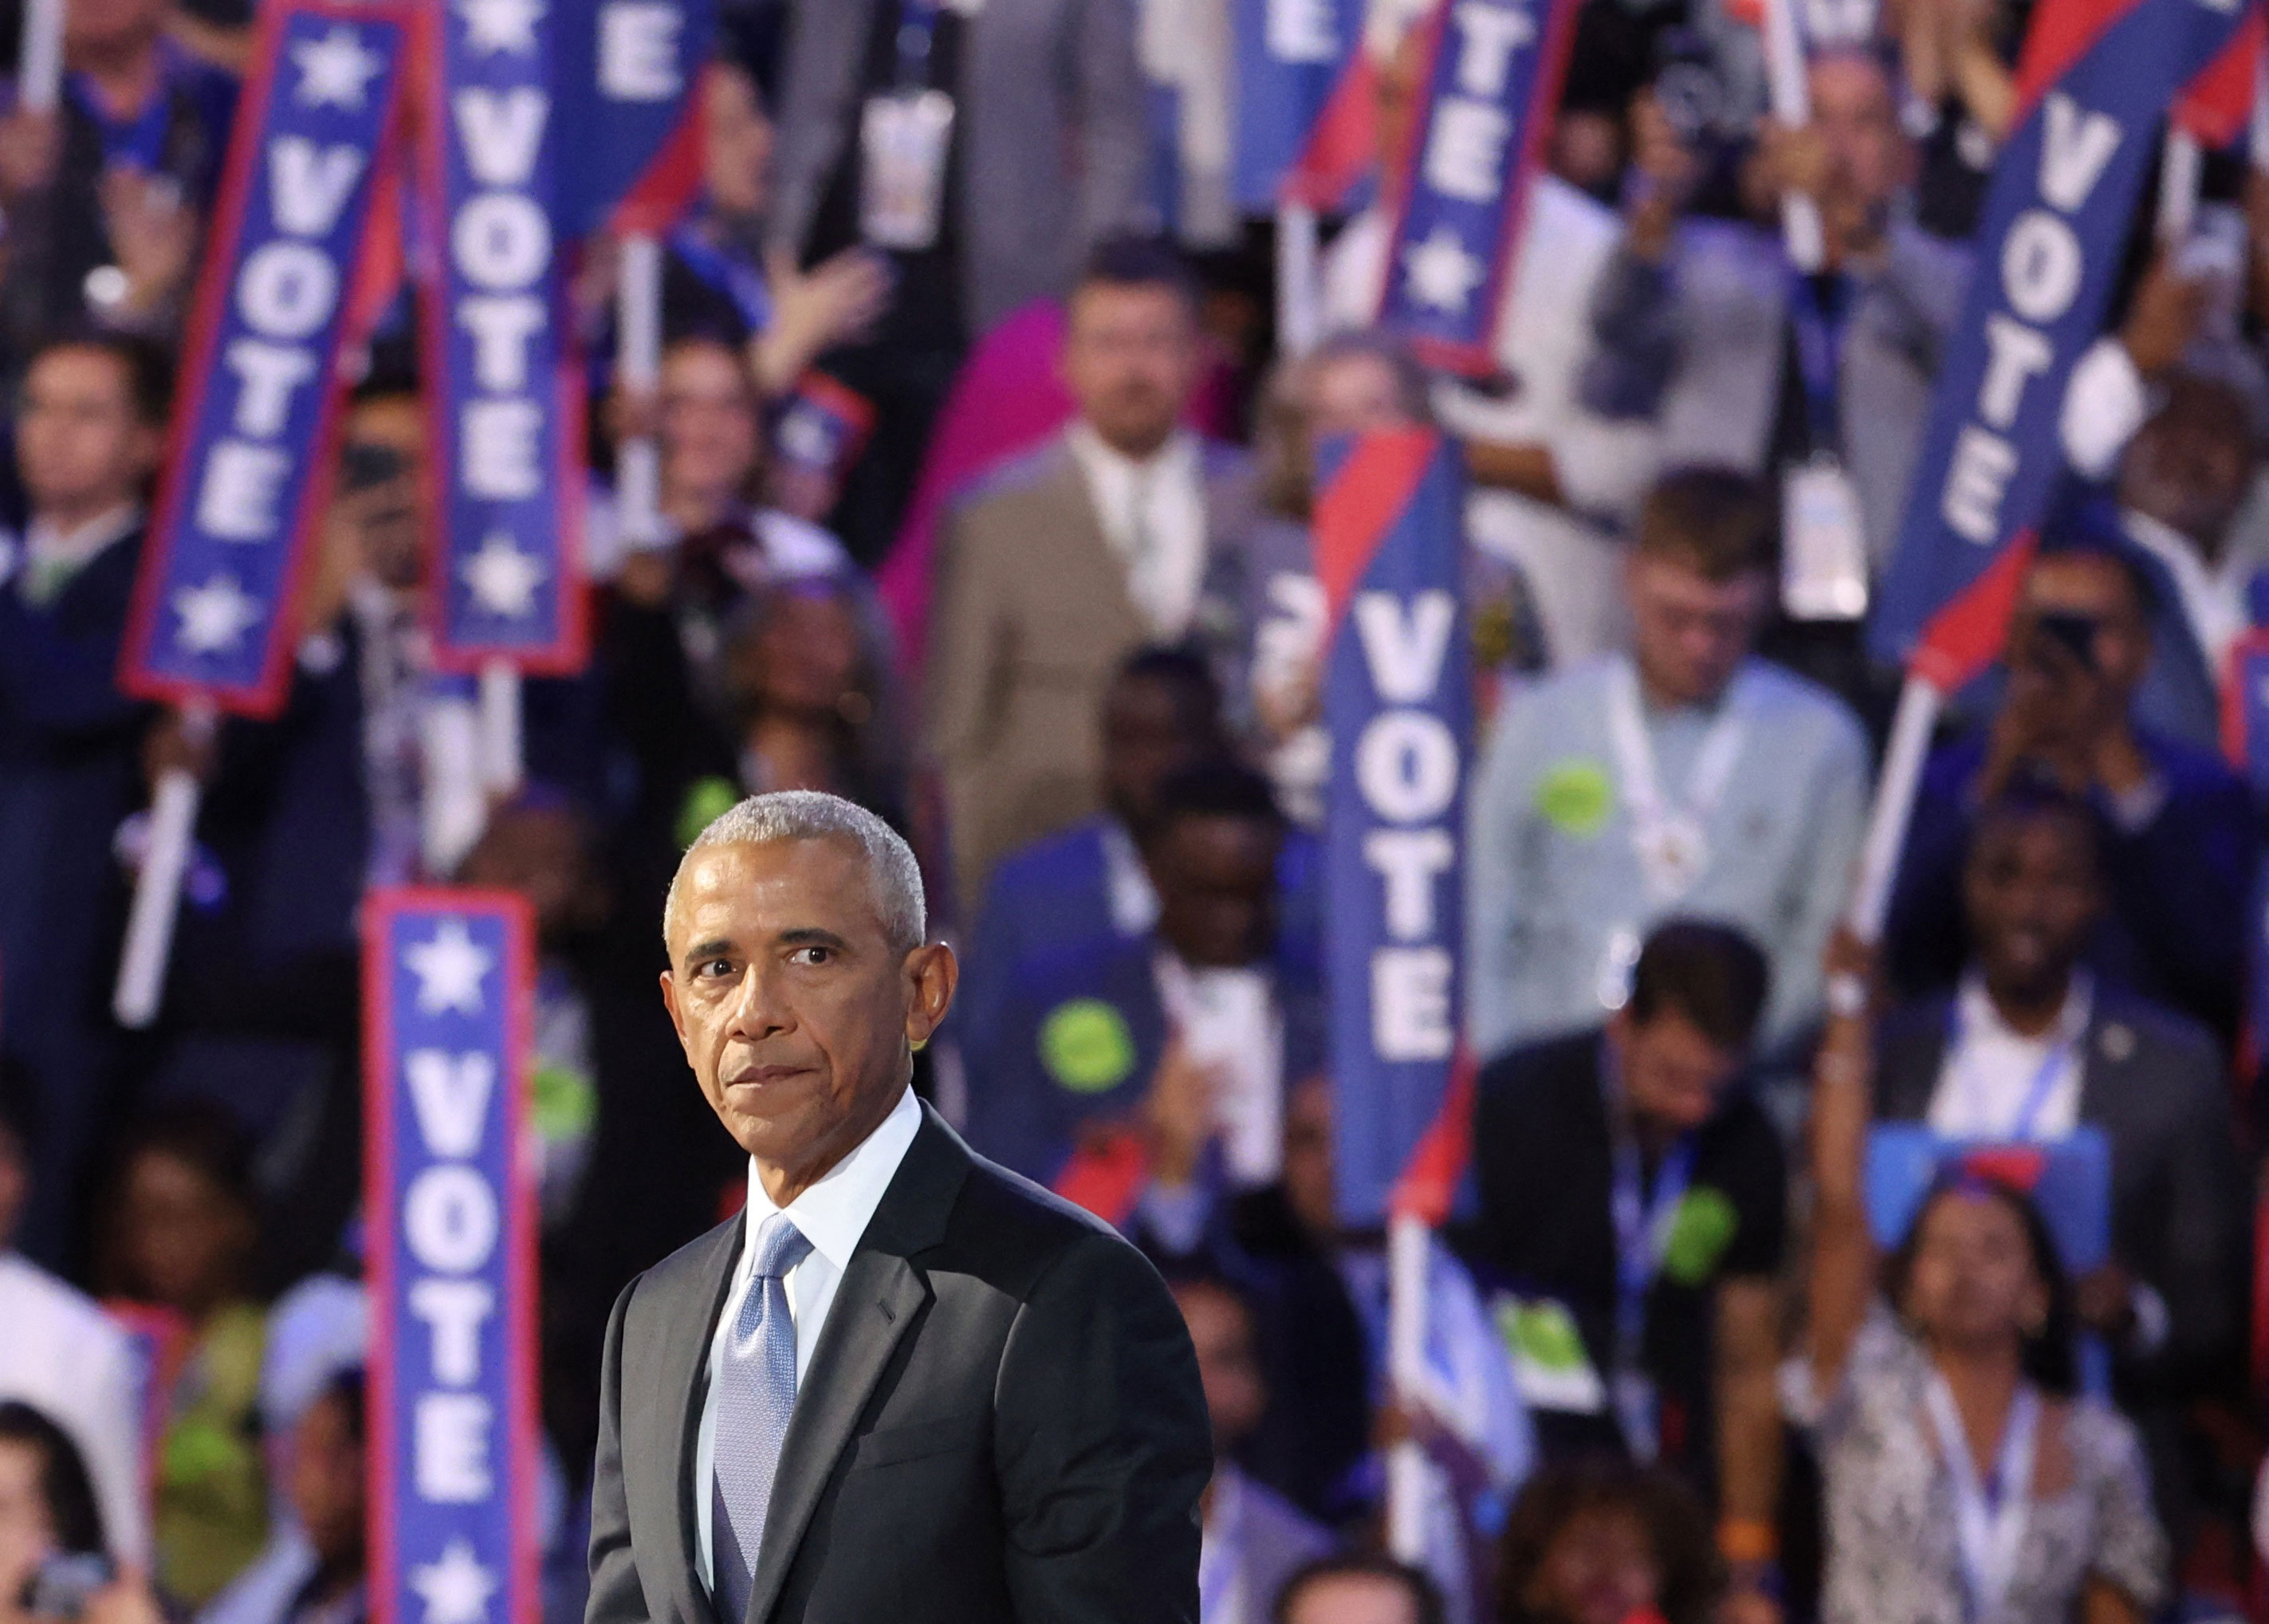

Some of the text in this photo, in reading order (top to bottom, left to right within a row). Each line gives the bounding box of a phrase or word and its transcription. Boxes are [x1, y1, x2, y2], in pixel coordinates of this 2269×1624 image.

[198, 137, 360, 539] VOTE
[454, 87, 548, 501] VOTE
[1945, 96, 2119, 542] VOTE
[1354, 590, 1457, 1063] VOTE
[403, 1046, 497, 1505] VOTE
